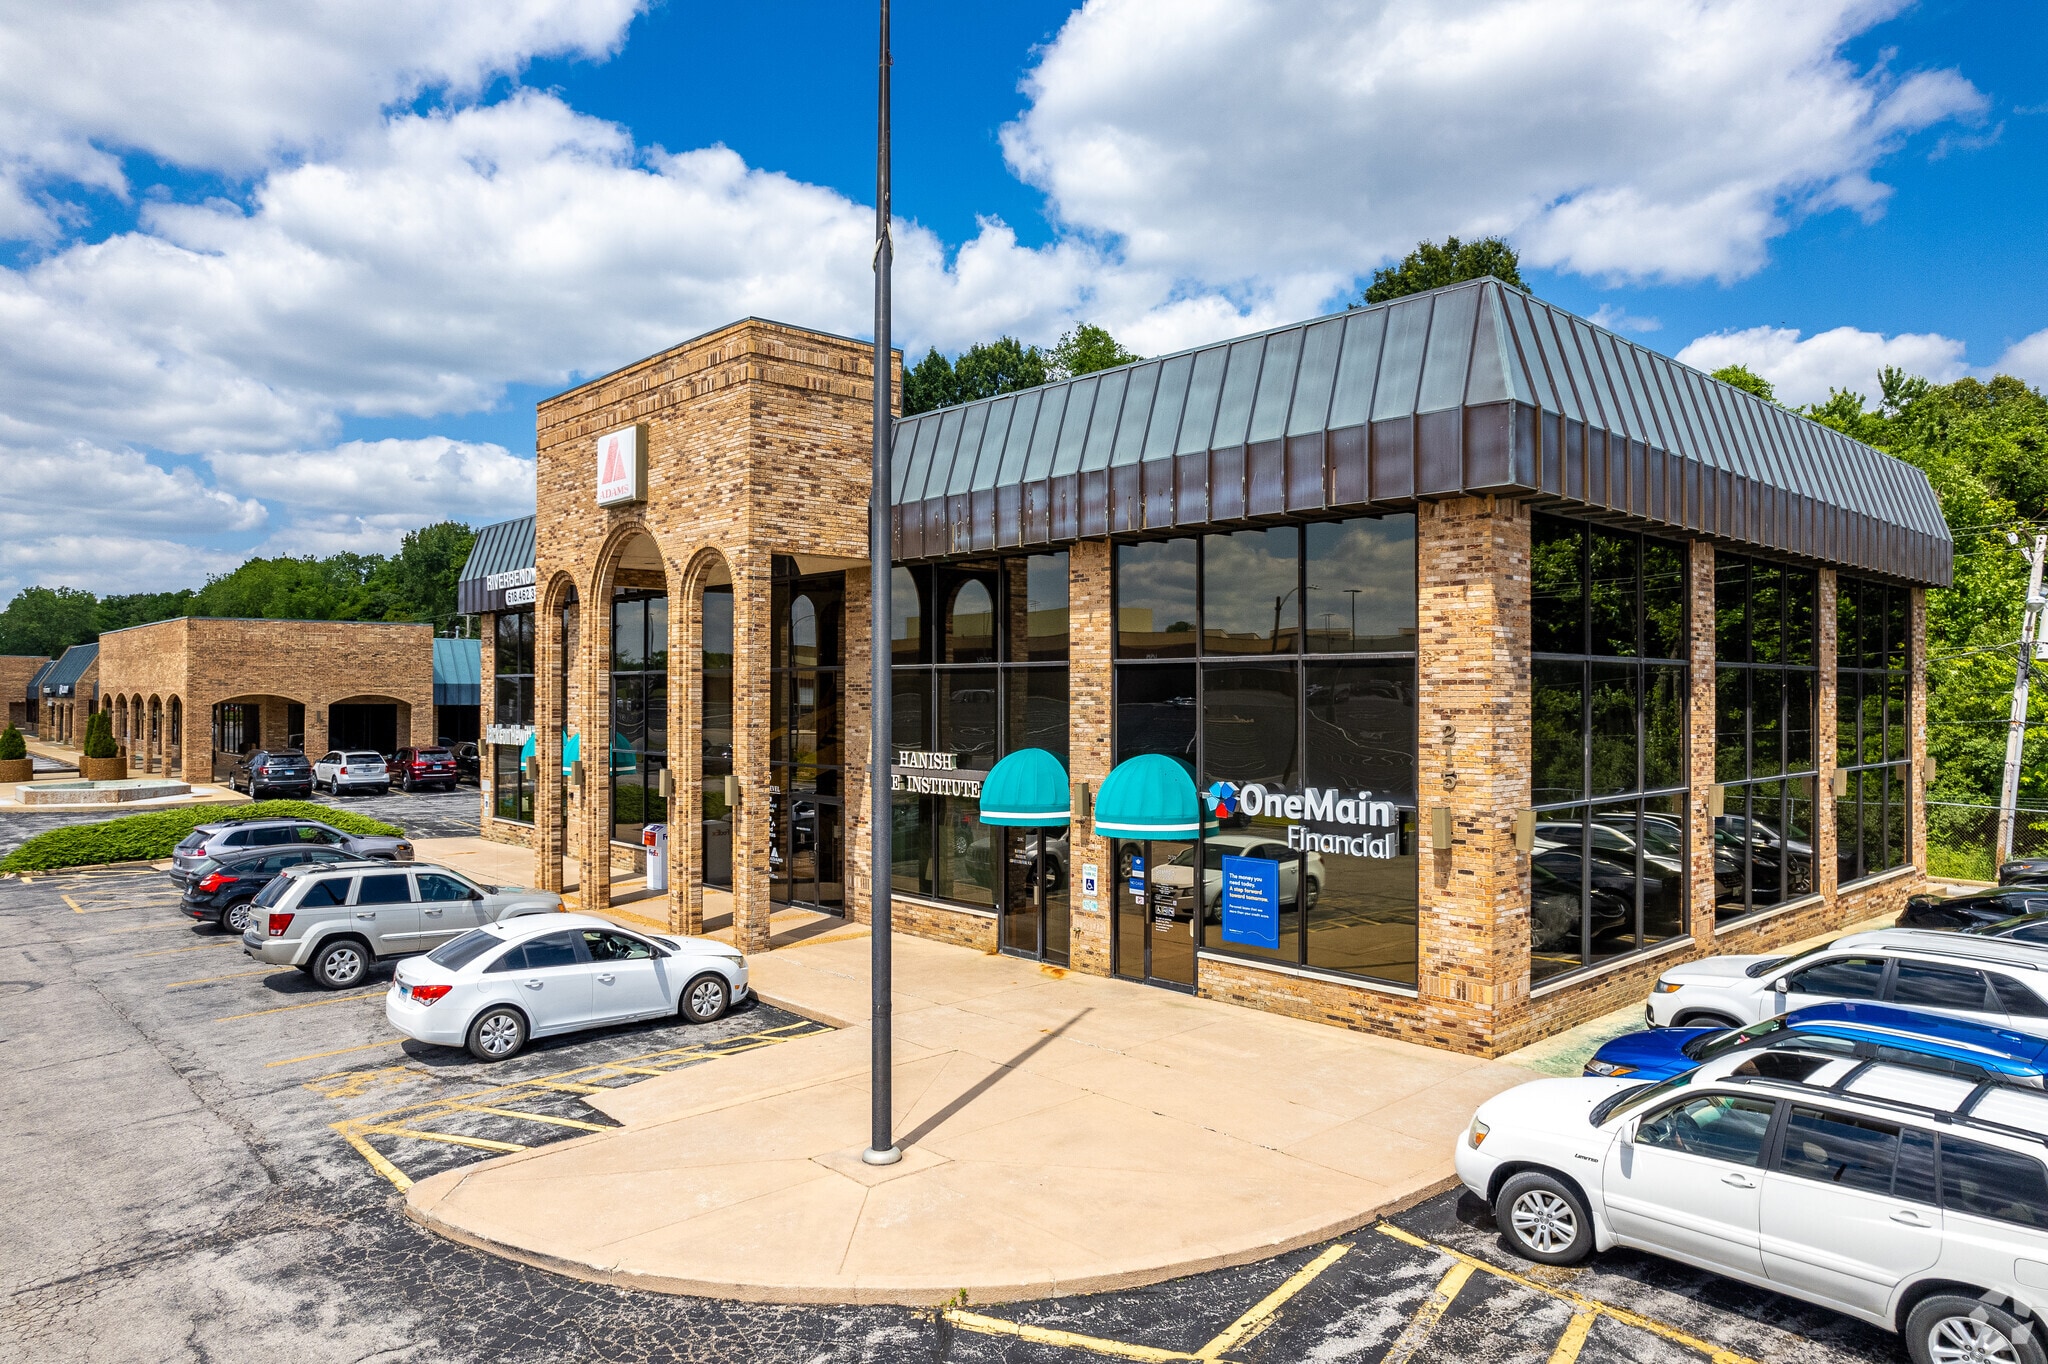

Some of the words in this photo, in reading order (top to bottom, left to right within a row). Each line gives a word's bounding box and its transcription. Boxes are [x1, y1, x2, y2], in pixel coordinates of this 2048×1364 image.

[600, 484, 629, 500] ADAMS
[487, 568, 531, 591] RIVERBEND
[899, 751, 955, 771] HANISH
[906, 776, 980, 798] INSTITUTE
[1240, 783, 1393, 827] OneMain
[1288, 825, 1395, 859] Financial
[1244, 887, 1263, 895] forward
